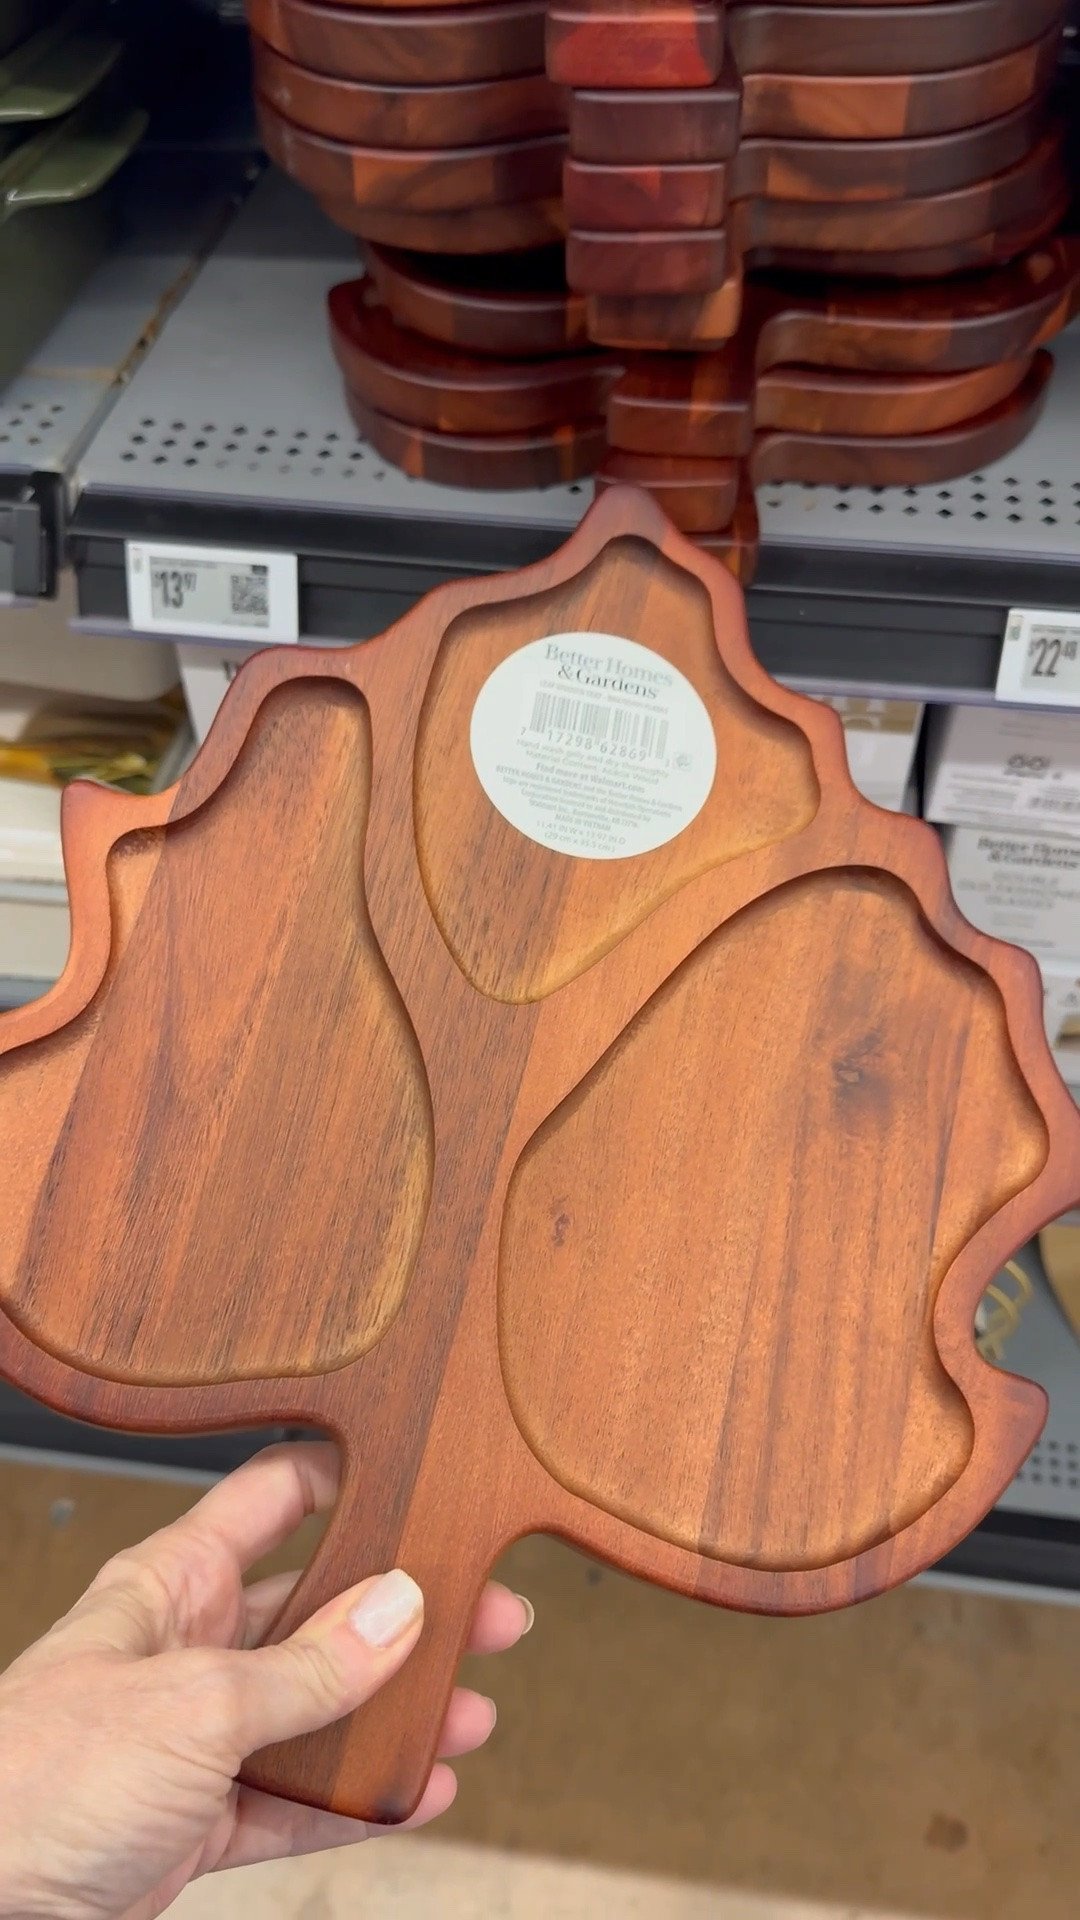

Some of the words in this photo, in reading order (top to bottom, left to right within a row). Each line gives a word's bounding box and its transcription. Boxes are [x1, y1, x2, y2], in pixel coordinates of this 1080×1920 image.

[545, 644, 603, 669] Better
[605, 657, 674, 684] Homes
[557, 664, 573, 679] &
[575, 668, 658, 698] Gardens
[515, 738, 539, 750] Hand
[586, 753, 603, 763] and
[520, 726, 526, 735] 7
[547, 729, 592, 750] 17298
[599, 741, 646, 761] 62869
[535, 762, 554, 773] Find
[555, 766, 578, 778] more
[579, 771, 588, 781] at
[589, 774, 645, 793] Walmart.com
